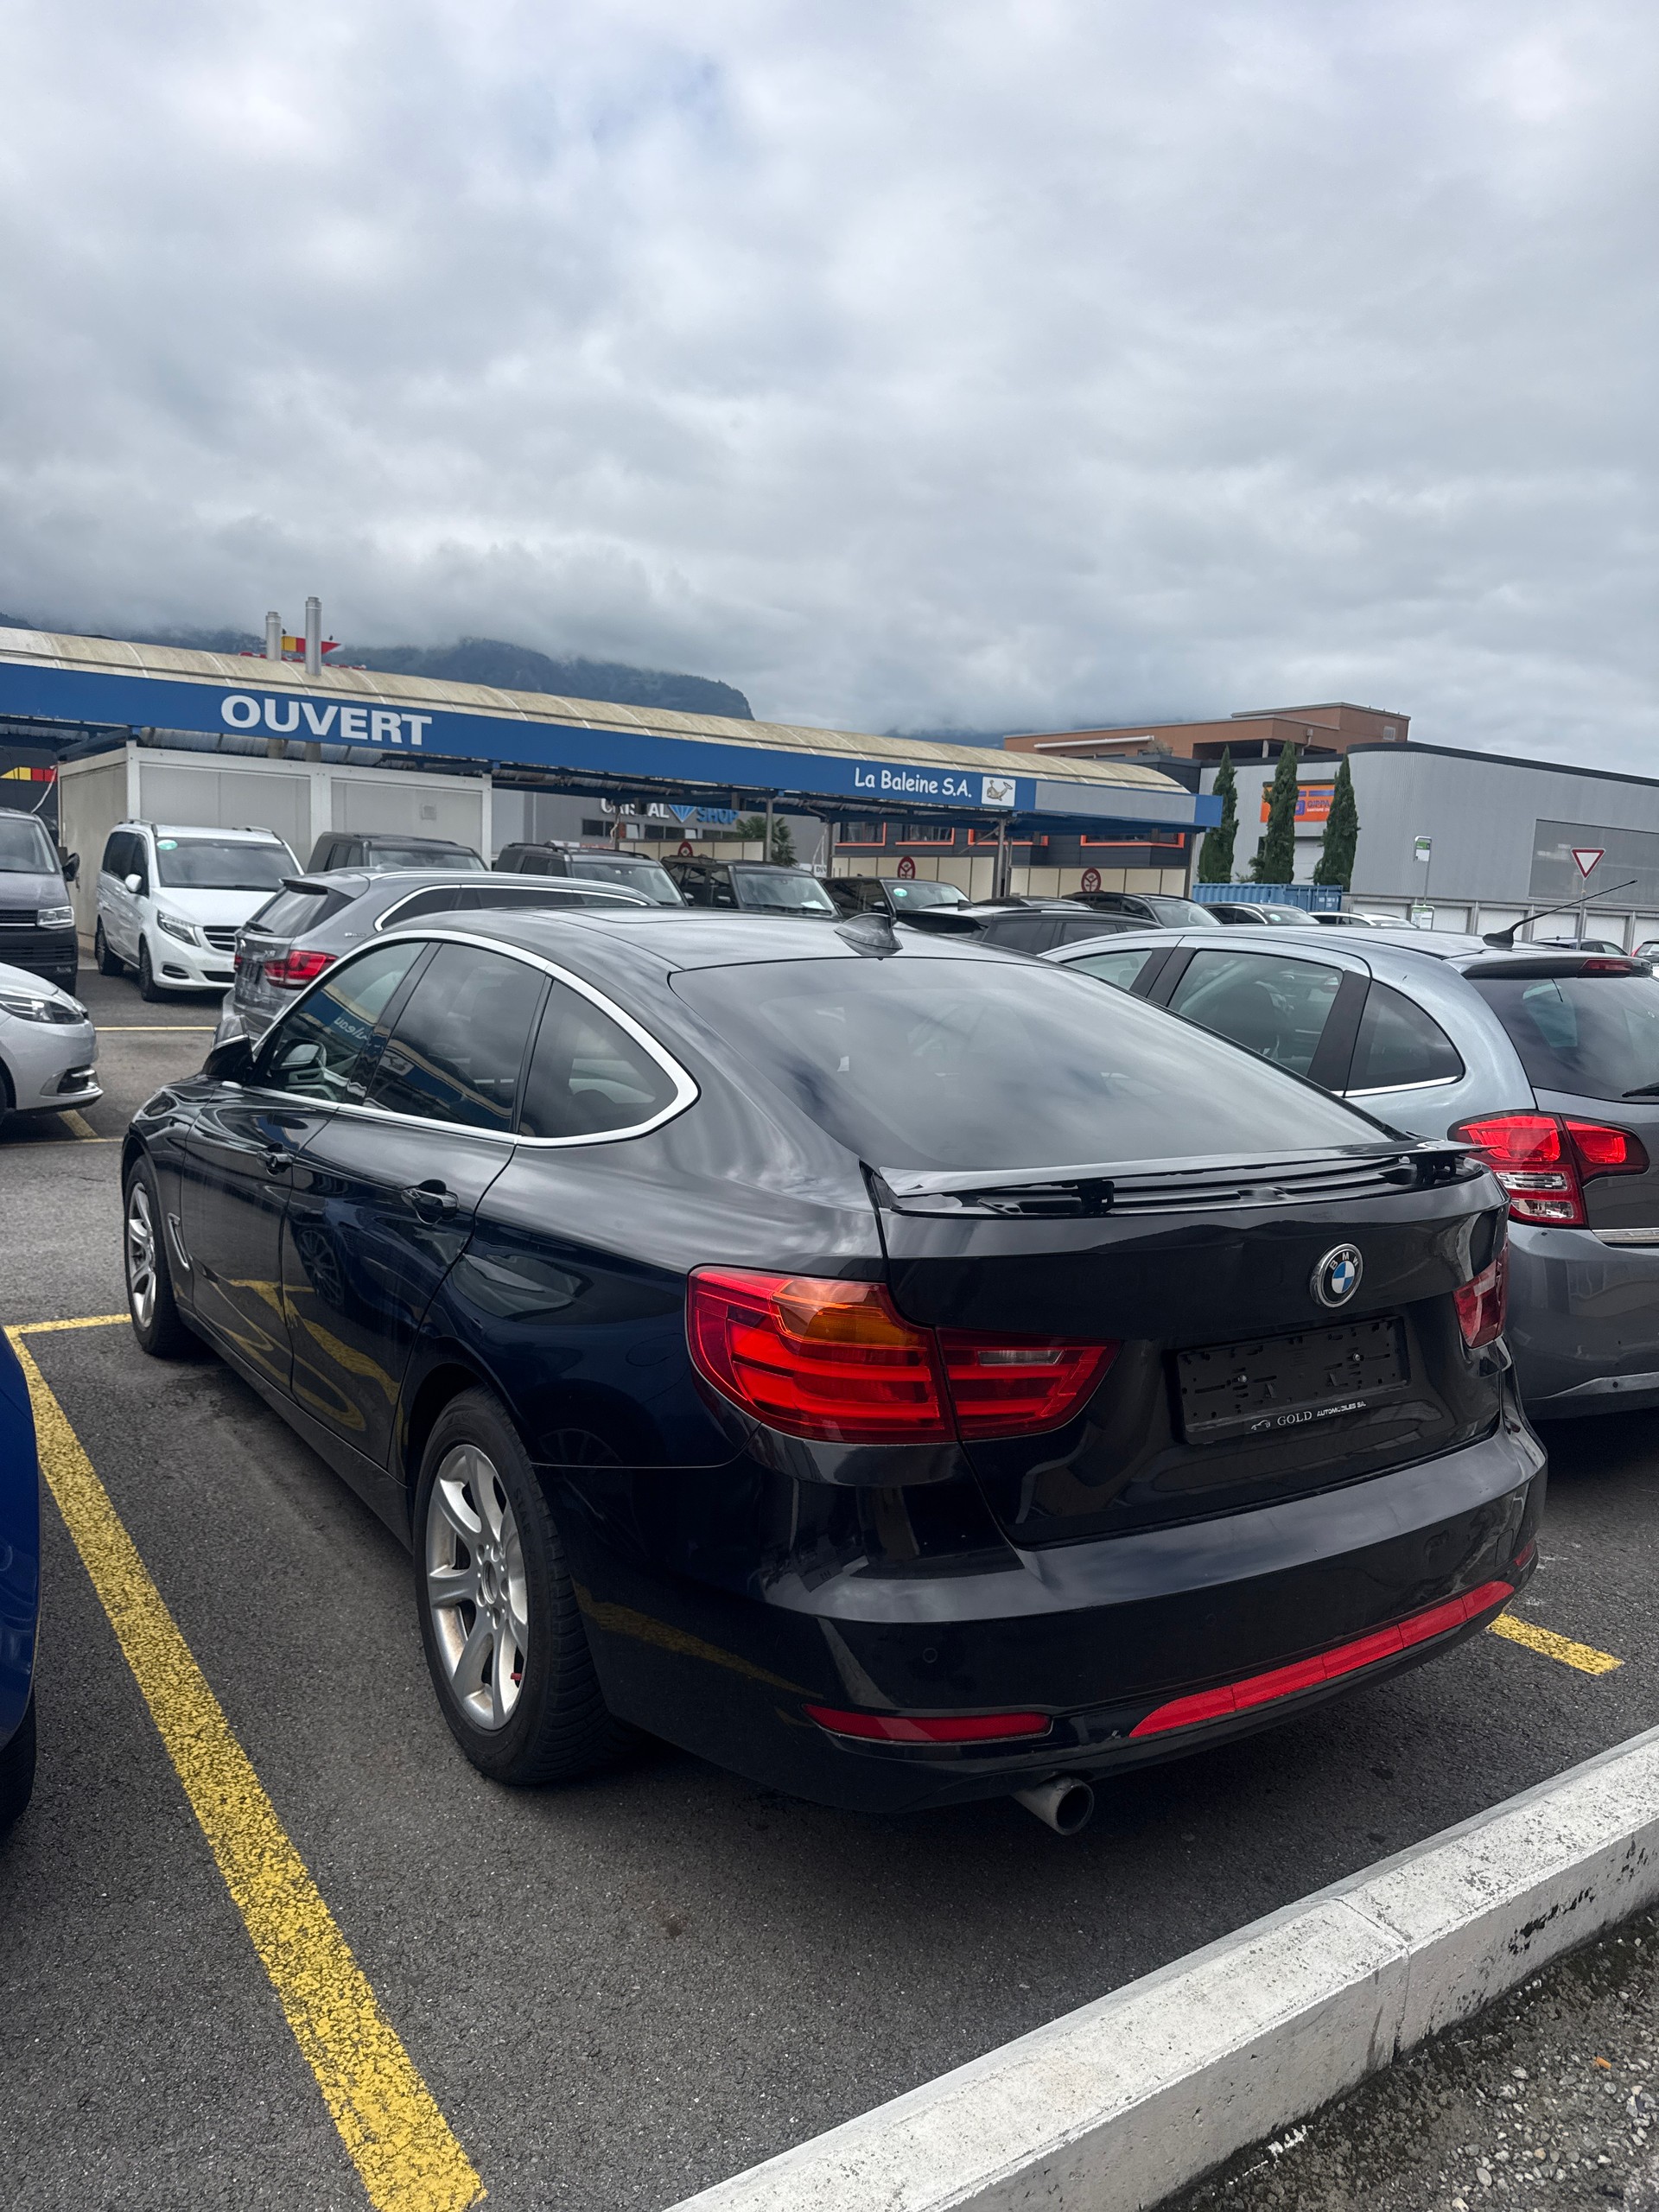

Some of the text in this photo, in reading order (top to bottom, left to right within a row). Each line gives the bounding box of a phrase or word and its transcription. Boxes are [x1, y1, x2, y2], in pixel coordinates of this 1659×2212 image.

[220, 695, 432, 746] OUVERT
[855, 766, 972, 798] La Baleine S.A.
[1329, 1251, 1359, 1271] BMW
[1277, 1411, 1313, 1426] GOLD
